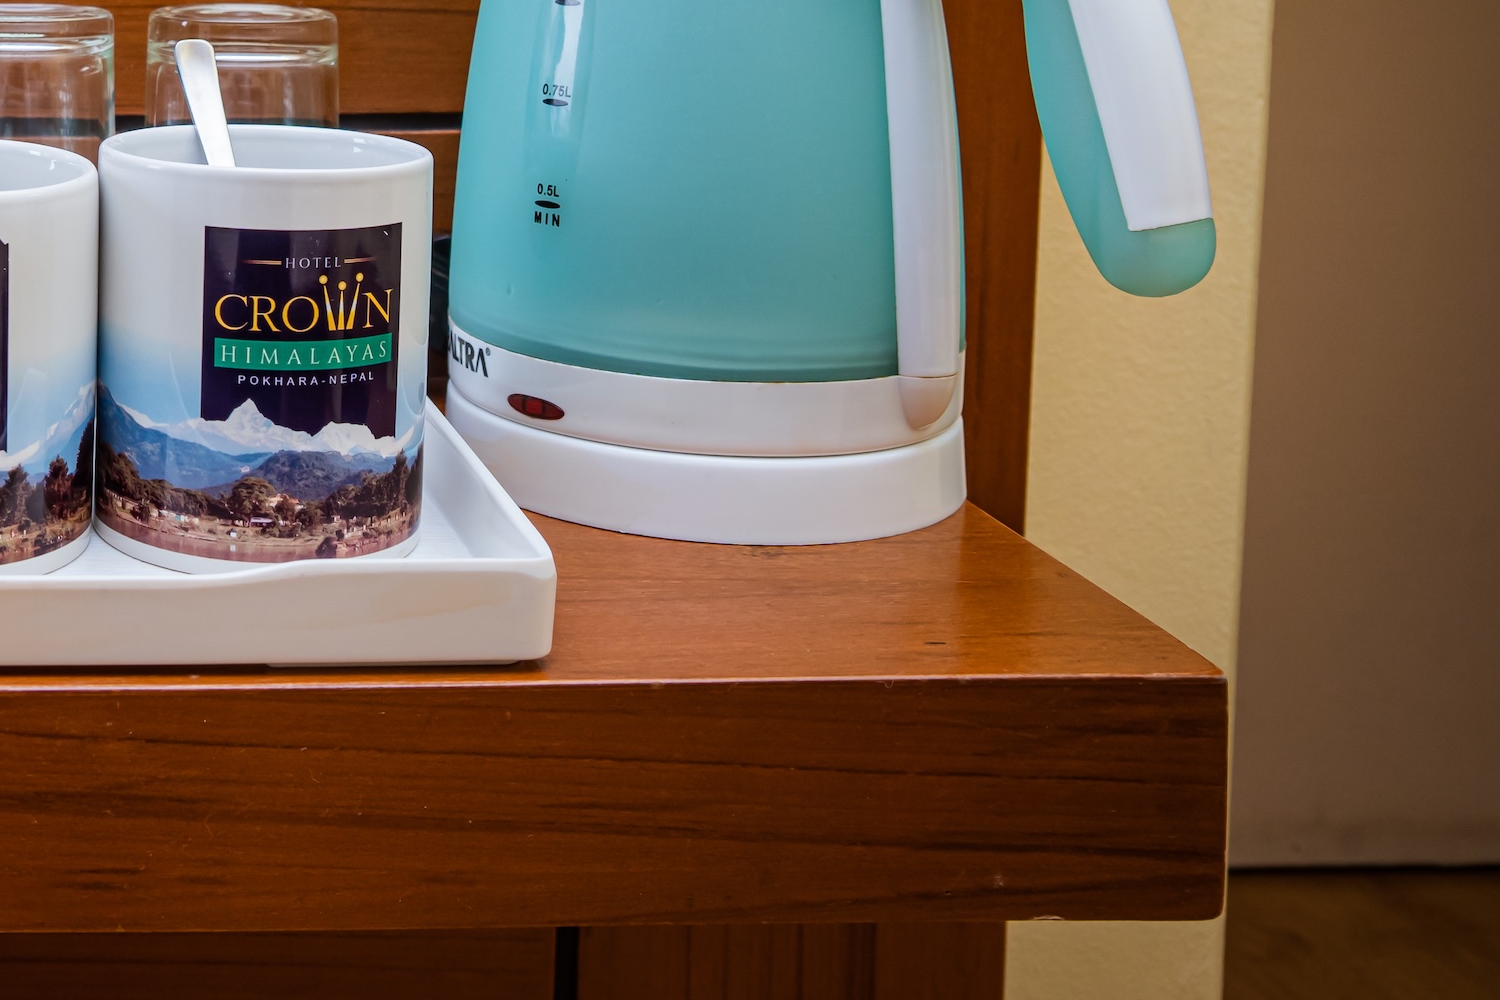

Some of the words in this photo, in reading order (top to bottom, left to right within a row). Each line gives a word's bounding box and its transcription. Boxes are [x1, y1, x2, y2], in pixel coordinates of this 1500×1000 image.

[542, 83, 571, 98] 0.75L
[537, 183, 560, 197] 0.5L
[534, 210, 560, 228] MIN
[284, 256, 341, 269] HOTEL
[214, 272, 393, 332] CROWN
[221, 340, 387, 365] HIMALAYAS
[237, 371, 374, 386] POKHARA-NEPAL
